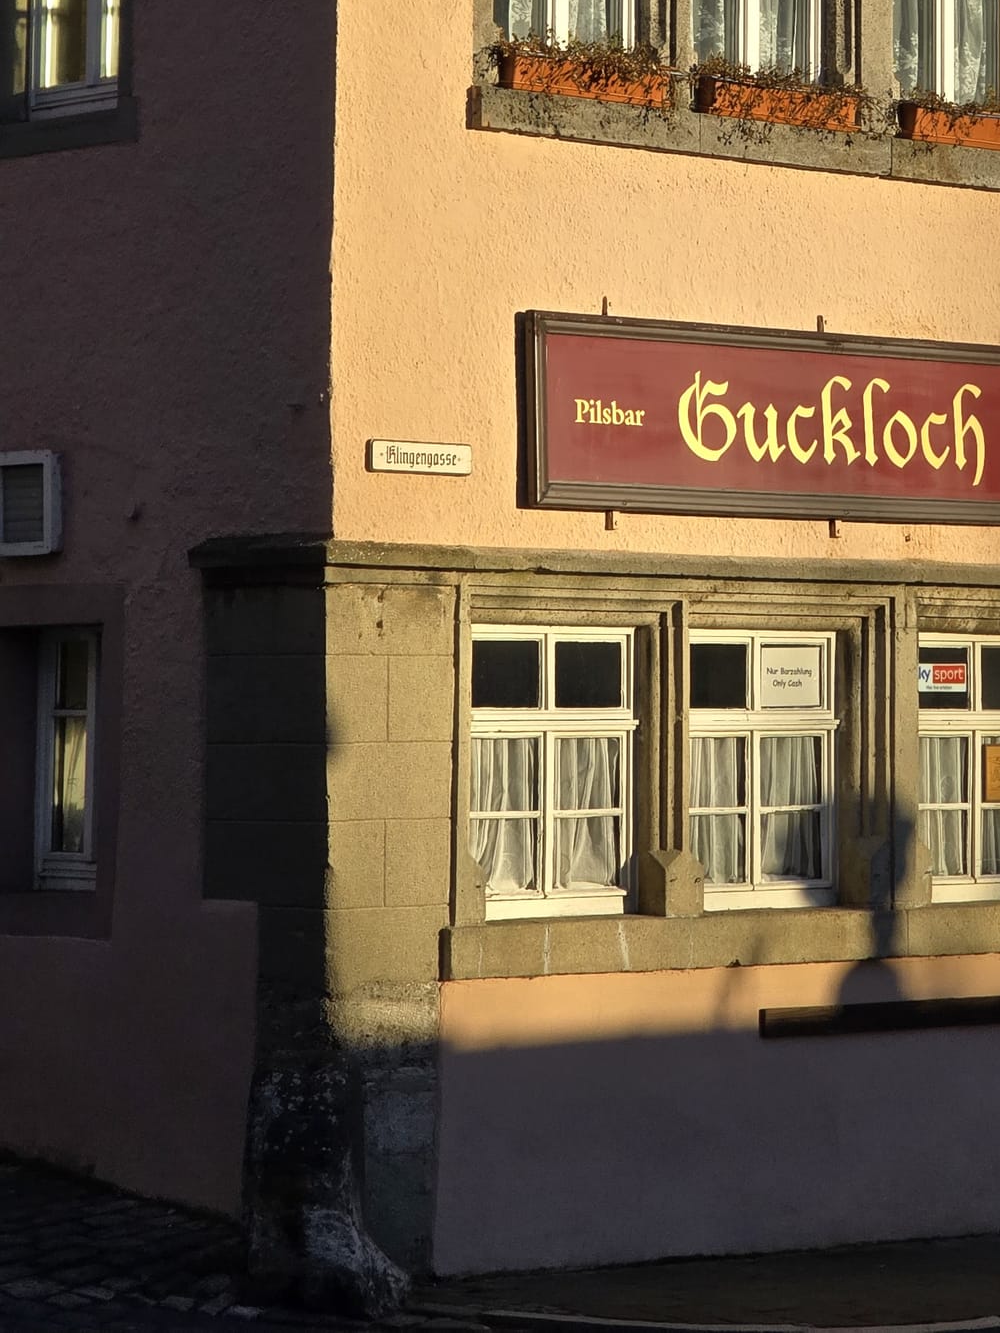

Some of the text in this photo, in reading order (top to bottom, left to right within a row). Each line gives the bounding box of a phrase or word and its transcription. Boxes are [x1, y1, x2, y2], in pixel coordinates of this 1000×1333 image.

[574, 398, 646, 427] Pilsbar
[678, 370, 986, 487] Guckloch
[386, 445, 457, 468] Klingengasse
[766, 667, 778, 675] Nur
[918, 666, 964, 683] ky sport
[772, 679, 802, 689] Only Cash
